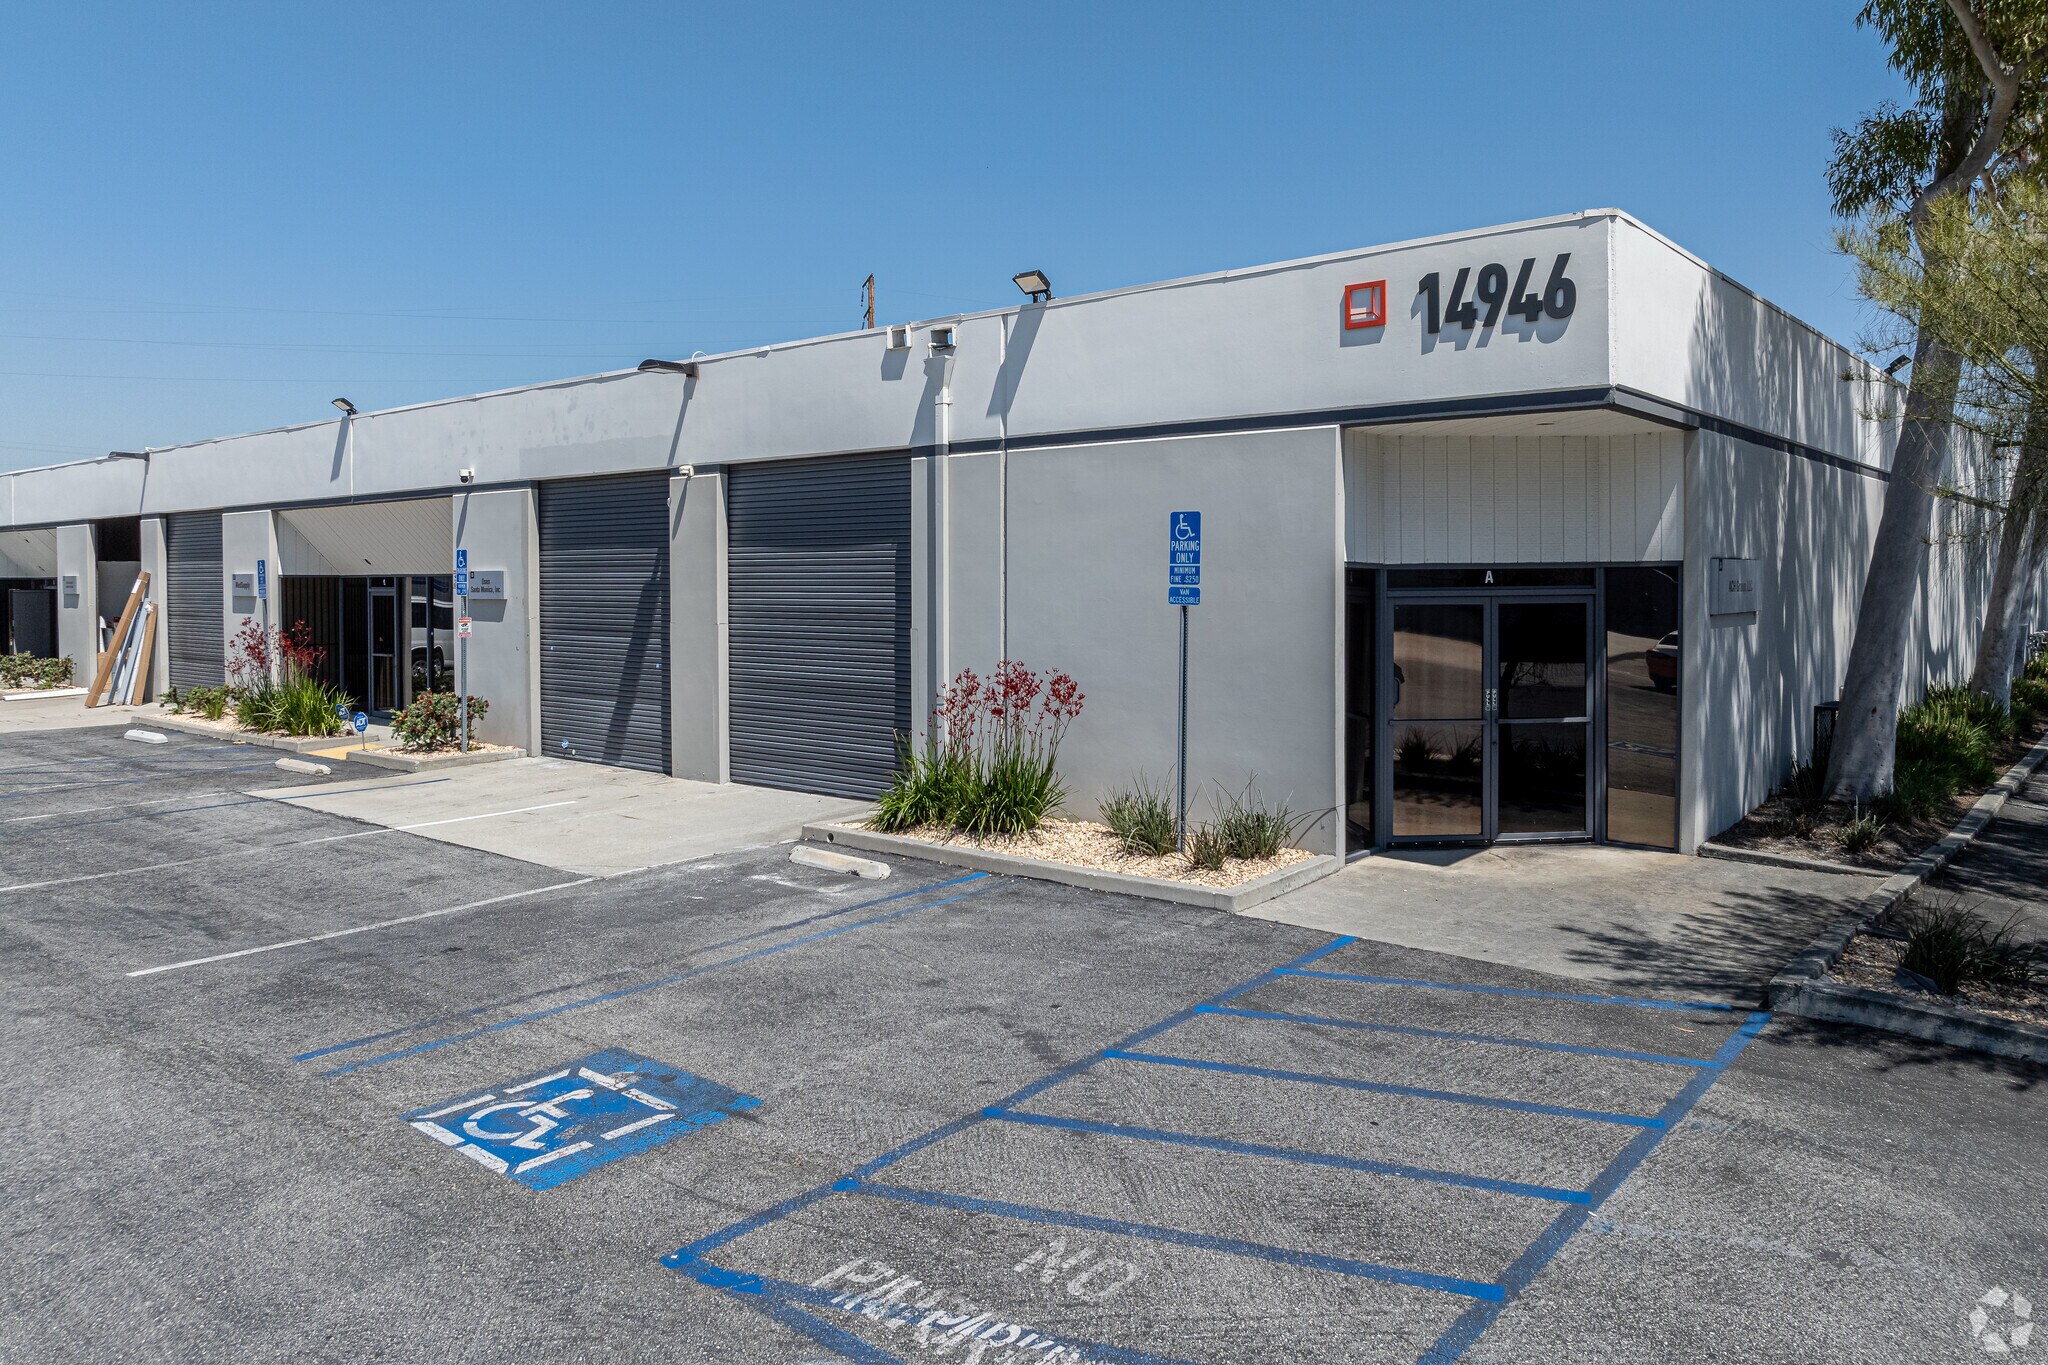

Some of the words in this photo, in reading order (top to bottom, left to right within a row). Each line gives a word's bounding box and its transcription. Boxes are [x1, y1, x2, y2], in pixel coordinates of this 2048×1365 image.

[1418, 252, 1577, 334] 14946
[1170, 540, 1200, 551] PARKING
[1175, 552, 1194, 564] ONLY
[1173, 566, 1196, 574] MINIMUM
[1170, 575, 1182, 583] FINE
[1184, 575, 1200, 583] $250
[1484, 570, 1494, 584] A
[1179, 588, 1190, 596] VAN
[1169, 596, 1200, 604] ACCESSIBLE
[355, 717, 367, 727] ADT
